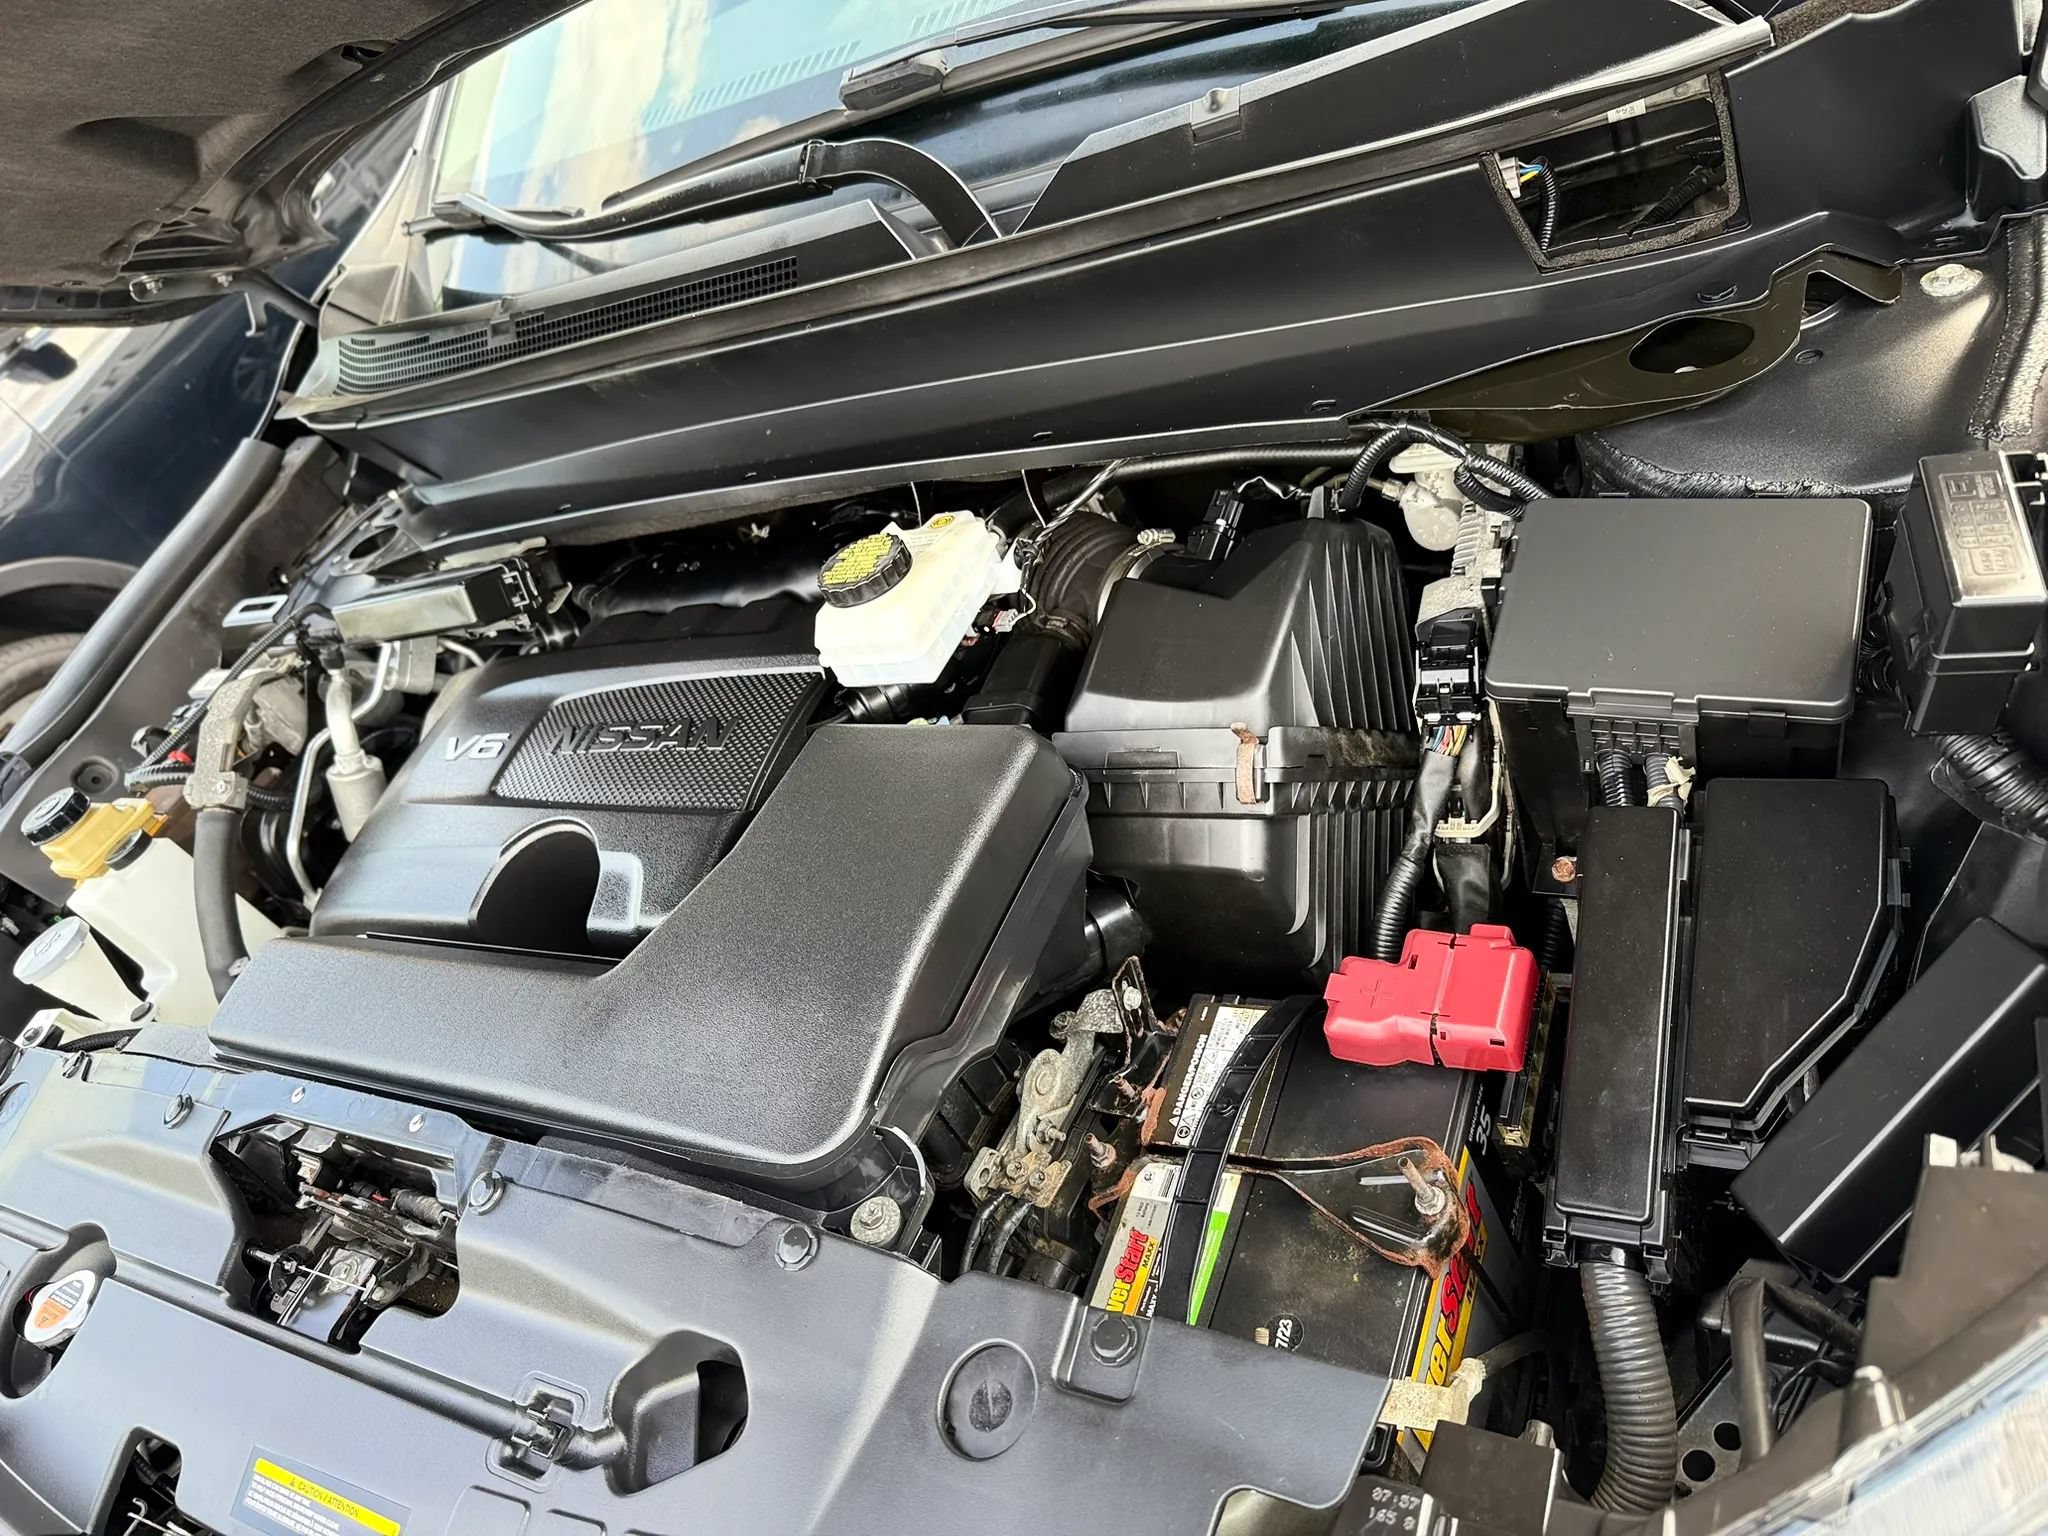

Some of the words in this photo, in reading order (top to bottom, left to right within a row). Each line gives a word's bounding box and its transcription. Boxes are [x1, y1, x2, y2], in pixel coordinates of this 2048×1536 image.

[445, 733, 512, 761] V6
[549, 717, 739, 755] NISSAN
[1173, 1034, 1209, 1115] DANGER/POISON
[1476, 1105, 1492, 1156] 35
[1106, 1228, 1148, 1312] verStart
[1142, 1241, 1155, 1268] MAXX
[297, 1482, 323, 1500] CAUTION
